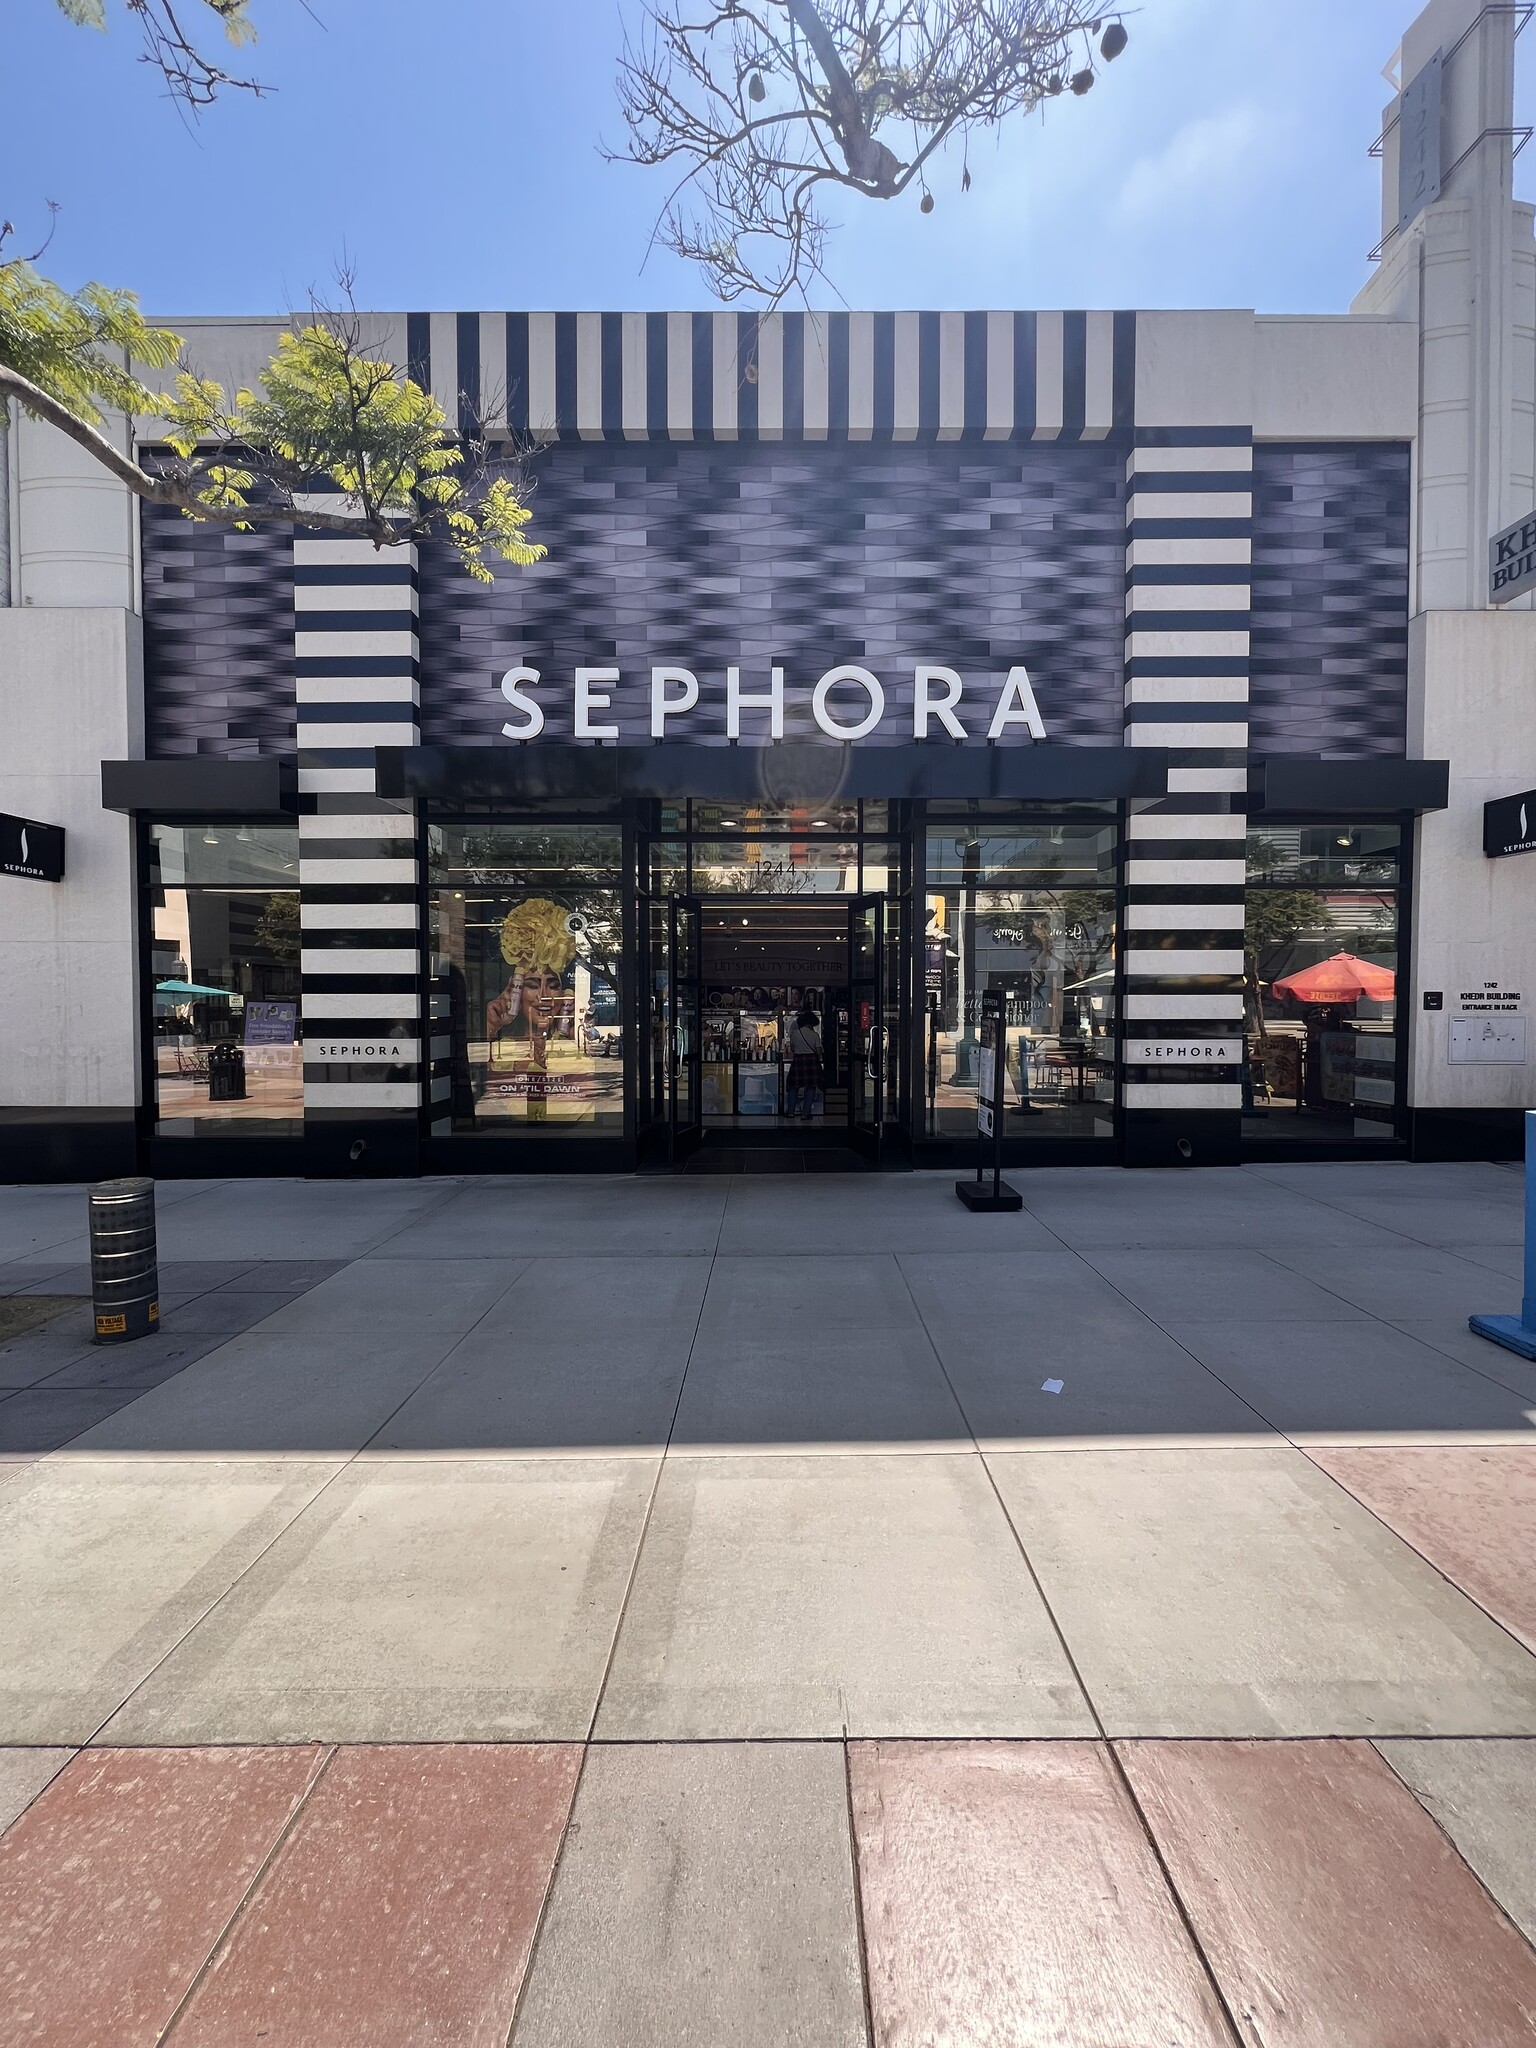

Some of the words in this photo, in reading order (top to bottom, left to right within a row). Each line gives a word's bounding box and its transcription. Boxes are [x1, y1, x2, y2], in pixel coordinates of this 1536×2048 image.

[1492, 550, 1536, 591] BUI
[500, 665, 1048, 740] SEPHORA
[4, 863, 44, 876] SEPHORA
[755, 860, 796, 876] 1244
[743, 961, 783, 972] BEAUTY
[785, 961, 843, 972] TOGETHER
[319, 1046, 400, 1056] SEPHORA
[1144, 1047, 1226, 1057] SEPHORA
